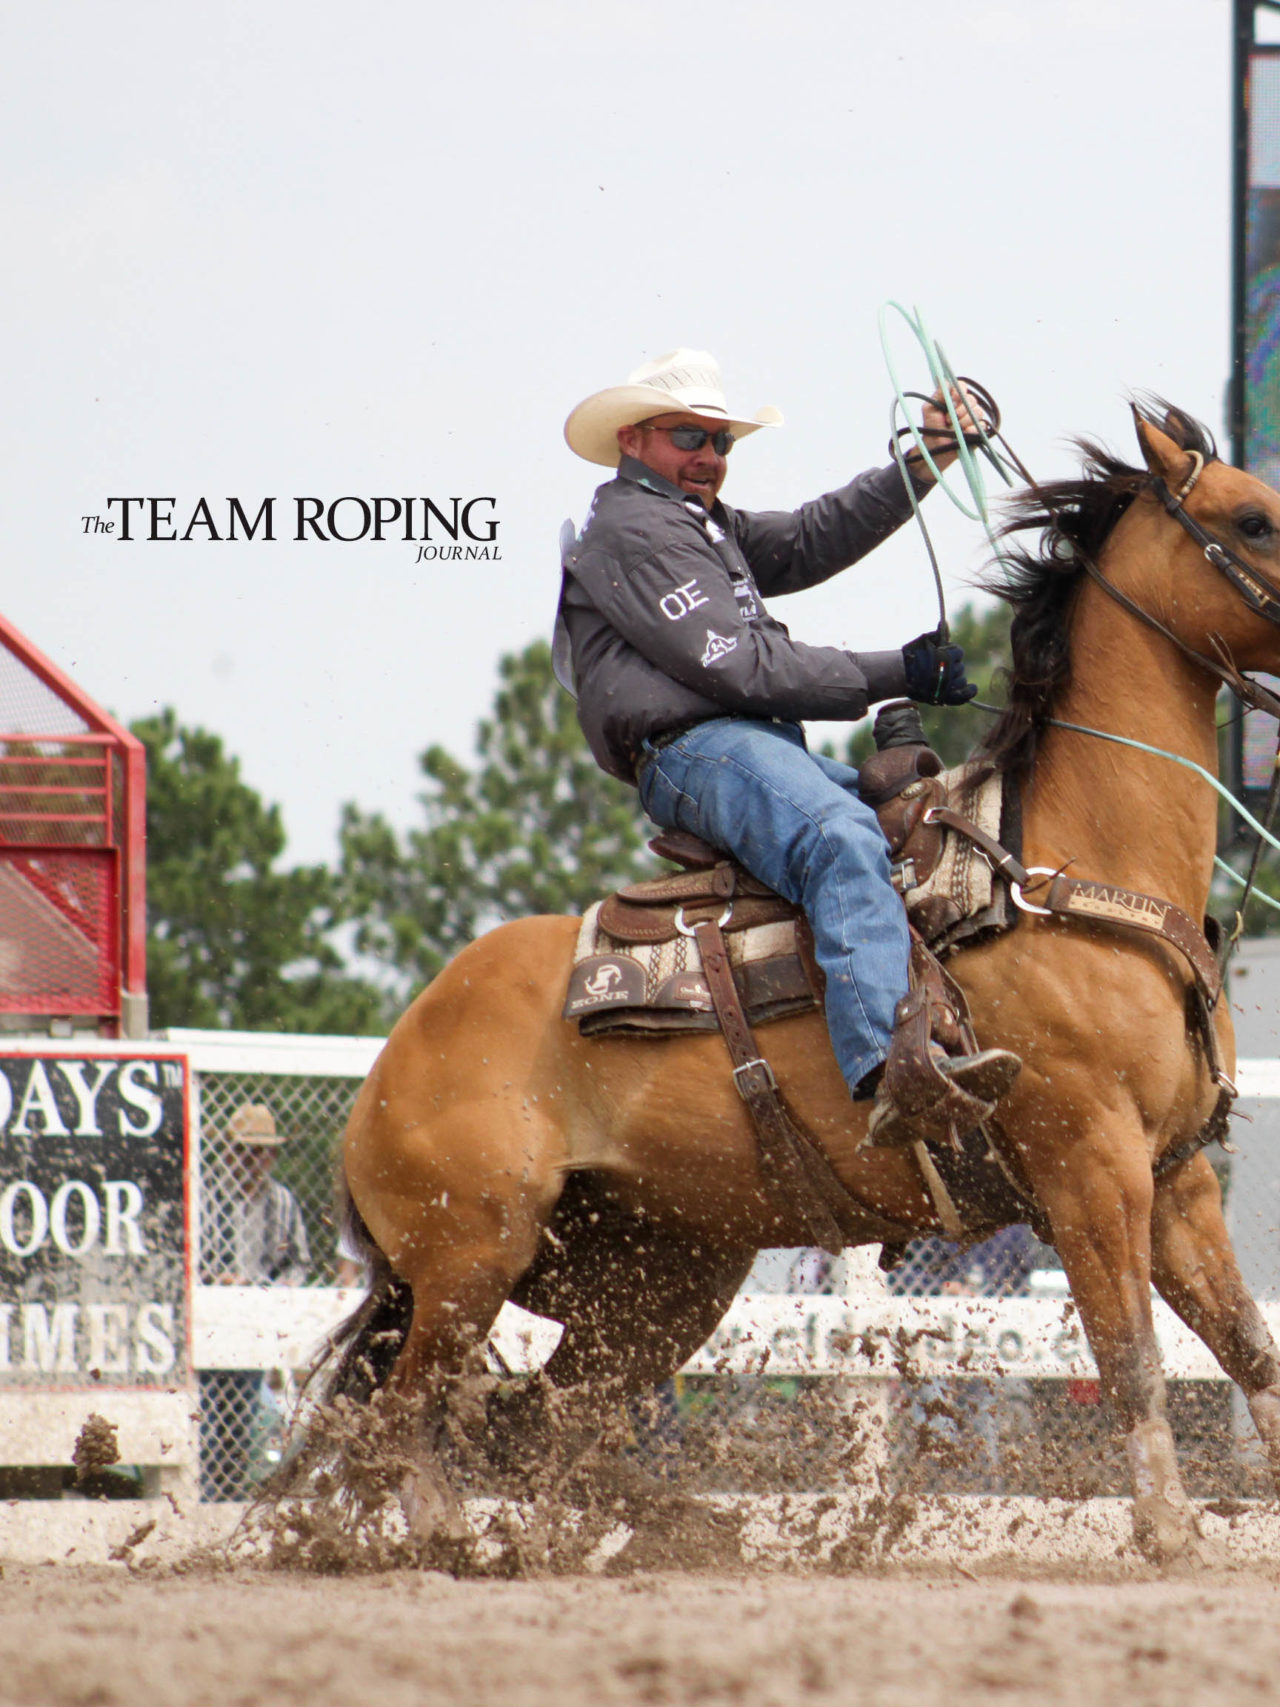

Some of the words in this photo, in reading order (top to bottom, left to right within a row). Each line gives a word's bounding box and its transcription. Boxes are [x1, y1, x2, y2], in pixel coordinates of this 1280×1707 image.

[1073, 883, 1168, 920] MARTIN
[0, 1059, 163, 1137] AYS
[0, 1180, 149, 1257] OOR
